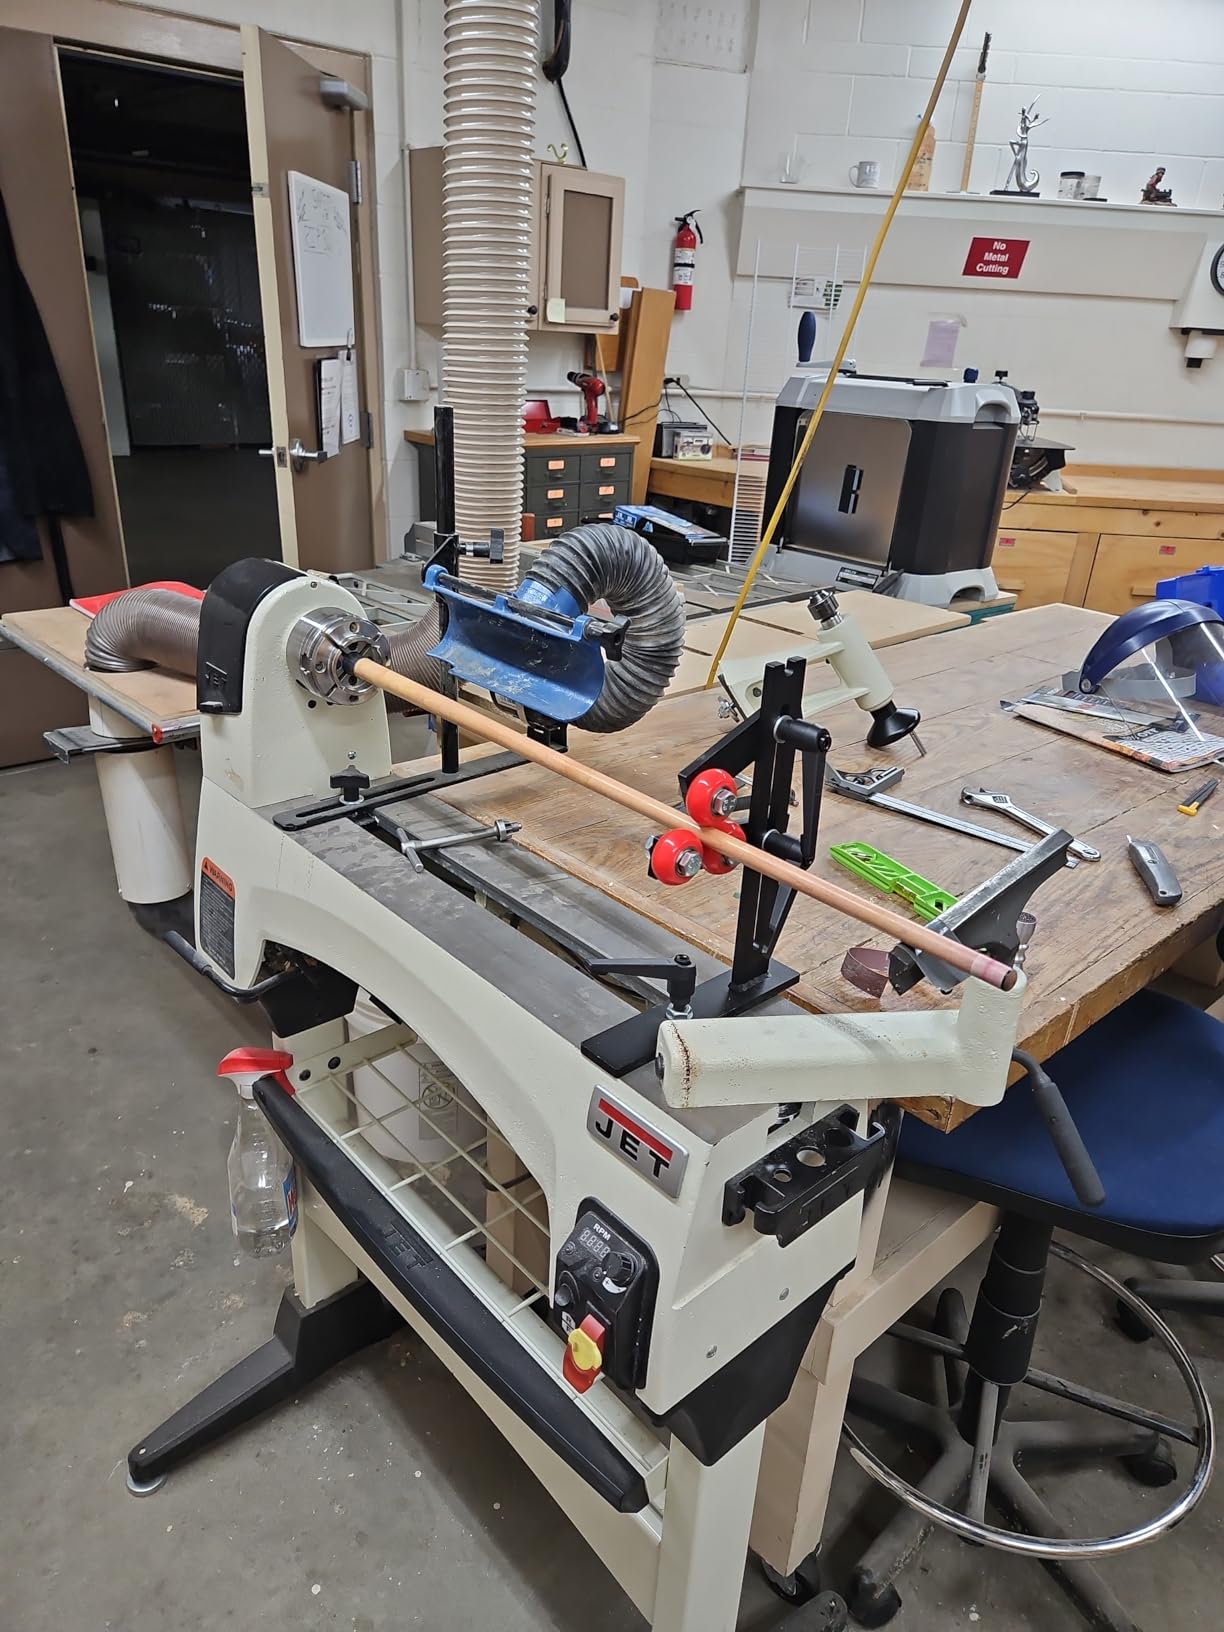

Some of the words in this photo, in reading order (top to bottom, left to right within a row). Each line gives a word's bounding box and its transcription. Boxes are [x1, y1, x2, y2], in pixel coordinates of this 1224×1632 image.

[992, 241, 1007, 250] No
[983, 252, 1009, 262] Metal
[975, 263, 1009, 275] Cutting
[209, 865, 233, 892] WARNING
[595, 1118, 671, 1178] JET
[592, 1223, 611, 1241] RPM
[384, 1228, 427, 1270] JET
